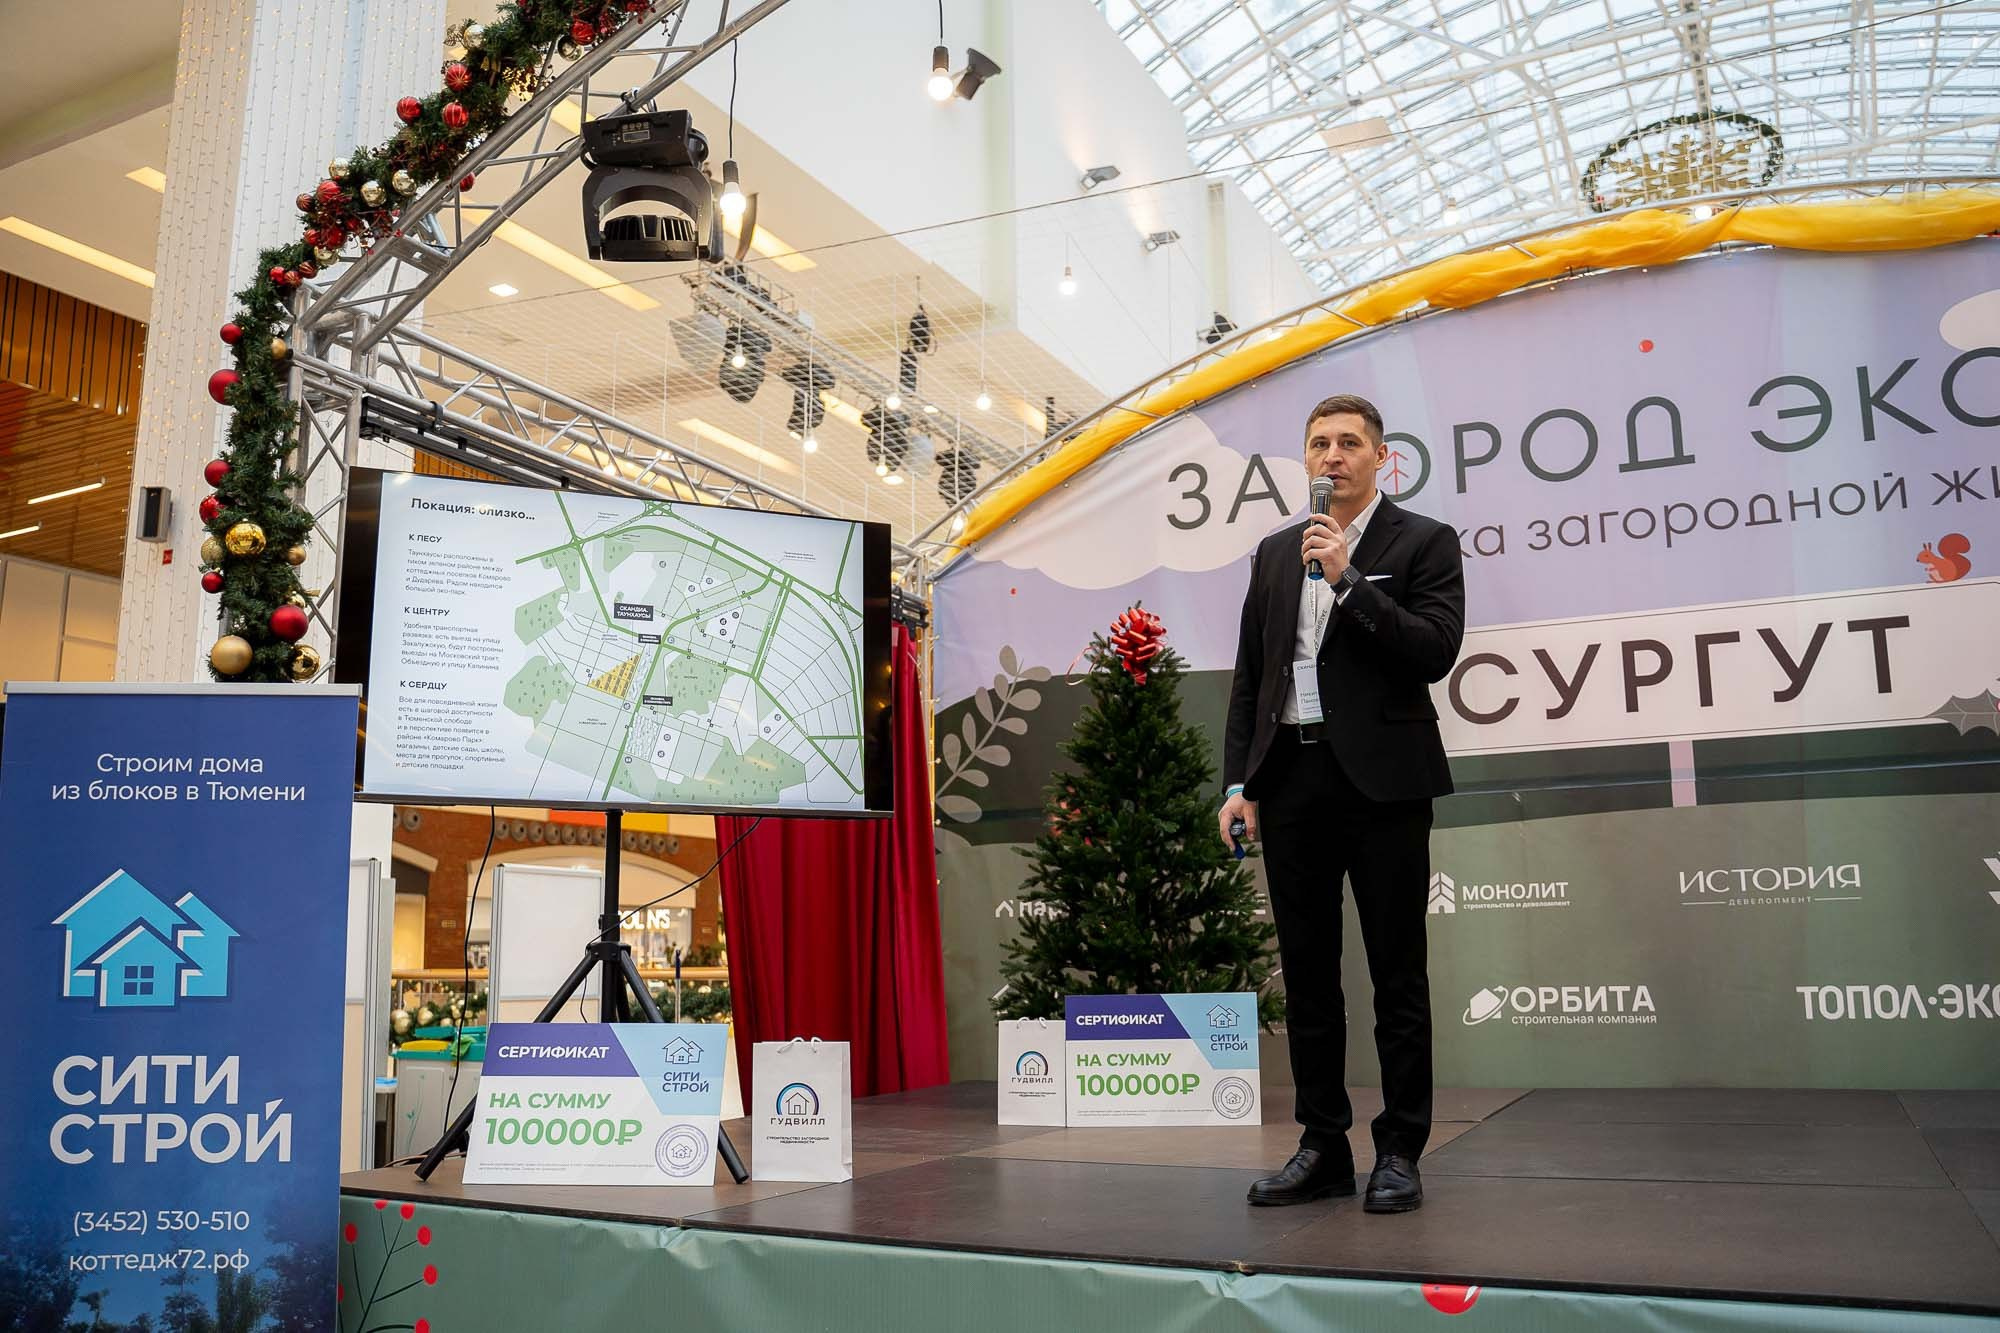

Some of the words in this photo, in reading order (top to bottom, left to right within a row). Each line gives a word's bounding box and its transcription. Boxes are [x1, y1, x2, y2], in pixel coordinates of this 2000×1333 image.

[1167, 396, 1696, 530] ЗАОРОД
[412, 498, 475, 514] Локация:
[1527, 472, 1908, 551] загородной
[1930, 465, 2000, 506] ж
[417, 534, 442, 543] ЛЕСУ
[404, 606, 410, 614] К
[412, 607, 450, 616] ЦЕНТРУ
[1447, 615, 1911, 725] СУРГУТ
[400, 680, 406, 688] К
[408, 681, 447, 690] СЕРДЦУ
[97, 753, 193, 776] Строим
[199, 755, 264, 775] дома
[52, 783, 80, 800] из
[88, 779, 178, 800] блоков
[186, 784, 199, 800] в
[207, 781, 306, 801] Тюмени
[1679, 864, 1862, 894] ИСТОРИЯ
[1462, 882, 1568, 901] МОНОЛИТ
[1463, 902, 1514, 910] строительство
[1728, 896, 1812, 906] ДЕВЕЛОПМЕНТ
[1510, 985, 1656, 1013] ОРБИТА
[1076, 1014, 1164, 1026] СЕРТИФИКАТ
[1511, 1015, 1594, 1026] строительная
[1597, 1014, 1657, 1025] компания
[1210, 1034, 1240, 1042] СИТИ
[1210, 1040, 1248, 1051] СТРОЙ
[498, 1045, 610, 1060] СЕРТИФИКАТ
[1076, 1054, 1102, 1066] НА
[1106, 1053, 1172, 1066] СУММУ
[52, 1055, 240, 1106] СИТИ
[663, 1072, 700, 1083] СИТИ
[662, 1080, 710, 1093] СТРОЙ
[489, 1093, 522, 1108] НА
[528, 1092, 612, 1109] СУММУ
[770, 1118, 825, 1126] ГУДВИЛЛ
[50, 1098, 292, 1164] СТРОЙ
[73, 1210, 148, 1236] (3452)
[156, 1210, 250, 1232] 530-510
[69, 1249, 250, 1274] коттедж72.рф
